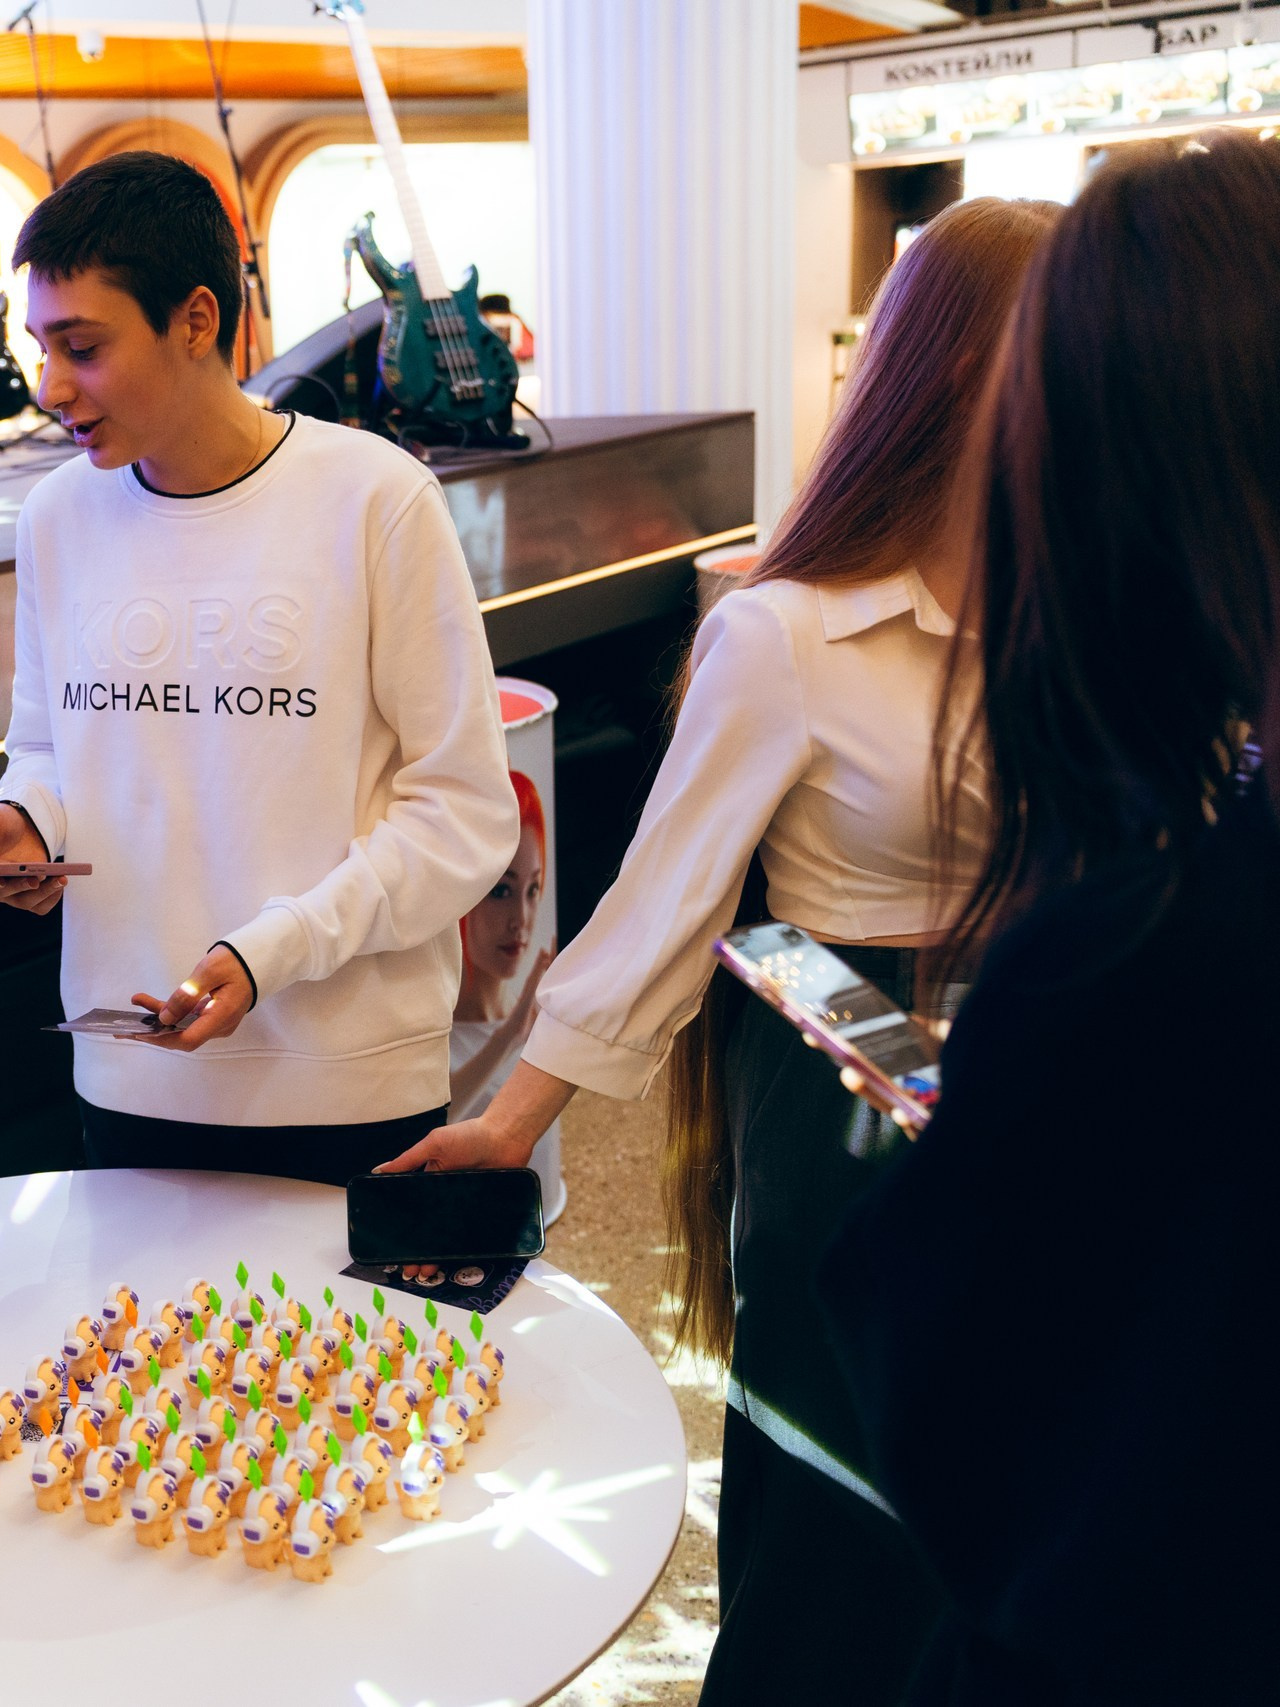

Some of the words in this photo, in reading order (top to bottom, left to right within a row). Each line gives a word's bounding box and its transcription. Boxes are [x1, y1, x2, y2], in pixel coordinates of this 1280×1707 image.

[885, 49, 1034, 83] КОКТЕЙЛИ
[71, 595, 303, 673] KORS
[63, 683, 200, 713] MICHAEL
[214, 686, 317, 718] KORS
